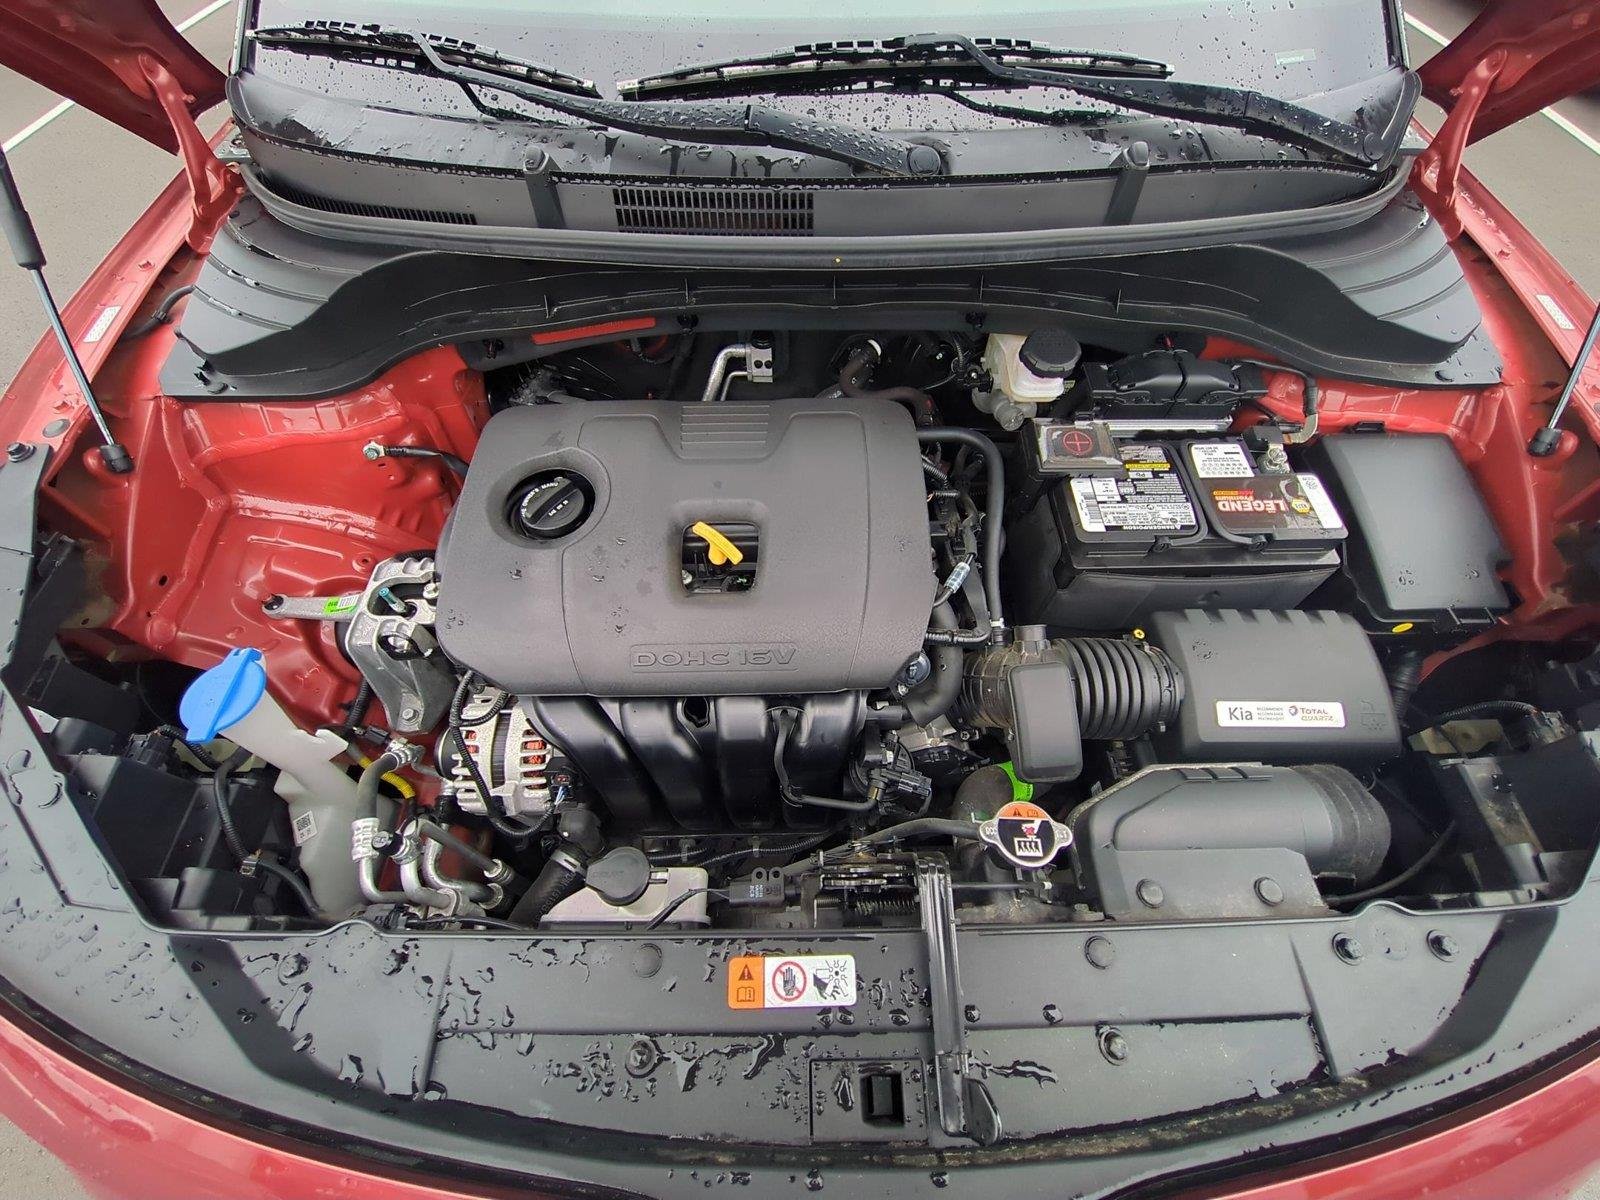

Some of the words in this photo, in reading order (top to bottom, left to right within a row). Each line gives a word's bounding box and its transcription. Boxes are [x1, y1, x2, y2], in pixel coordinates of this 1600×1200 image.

[1217, 499, 1288, 512] LEGEND
[633, 650, 730, 667] DOHC
[740, 648, 797, 666] 16V
[1228, 706, 1254, 721] Kia
[1300, 707, 1329, 715] TOTAL
